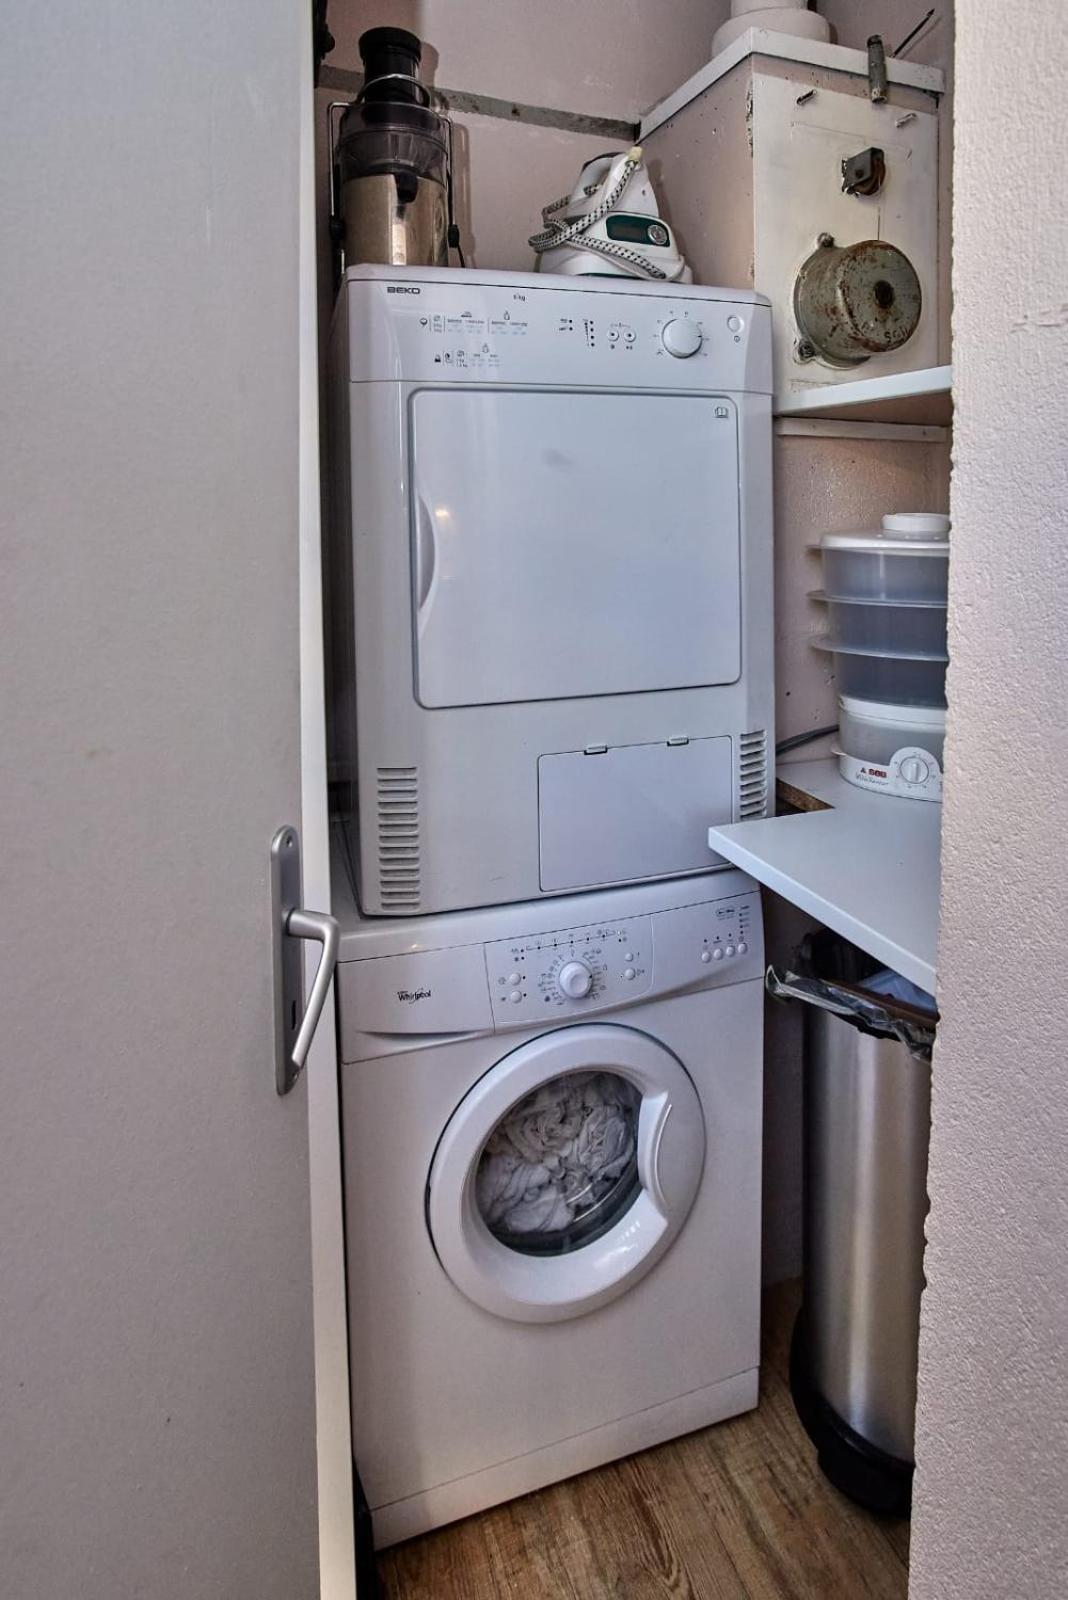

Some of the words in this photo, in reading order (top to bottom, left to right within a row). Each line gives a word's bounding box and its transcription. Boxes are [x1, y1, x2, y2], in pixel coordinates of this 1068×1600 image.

[387, 286, 421, 294] BEKO
[868, 768, 887, 778] SEB
[397, 988, 431, 1003] Whirlpool
